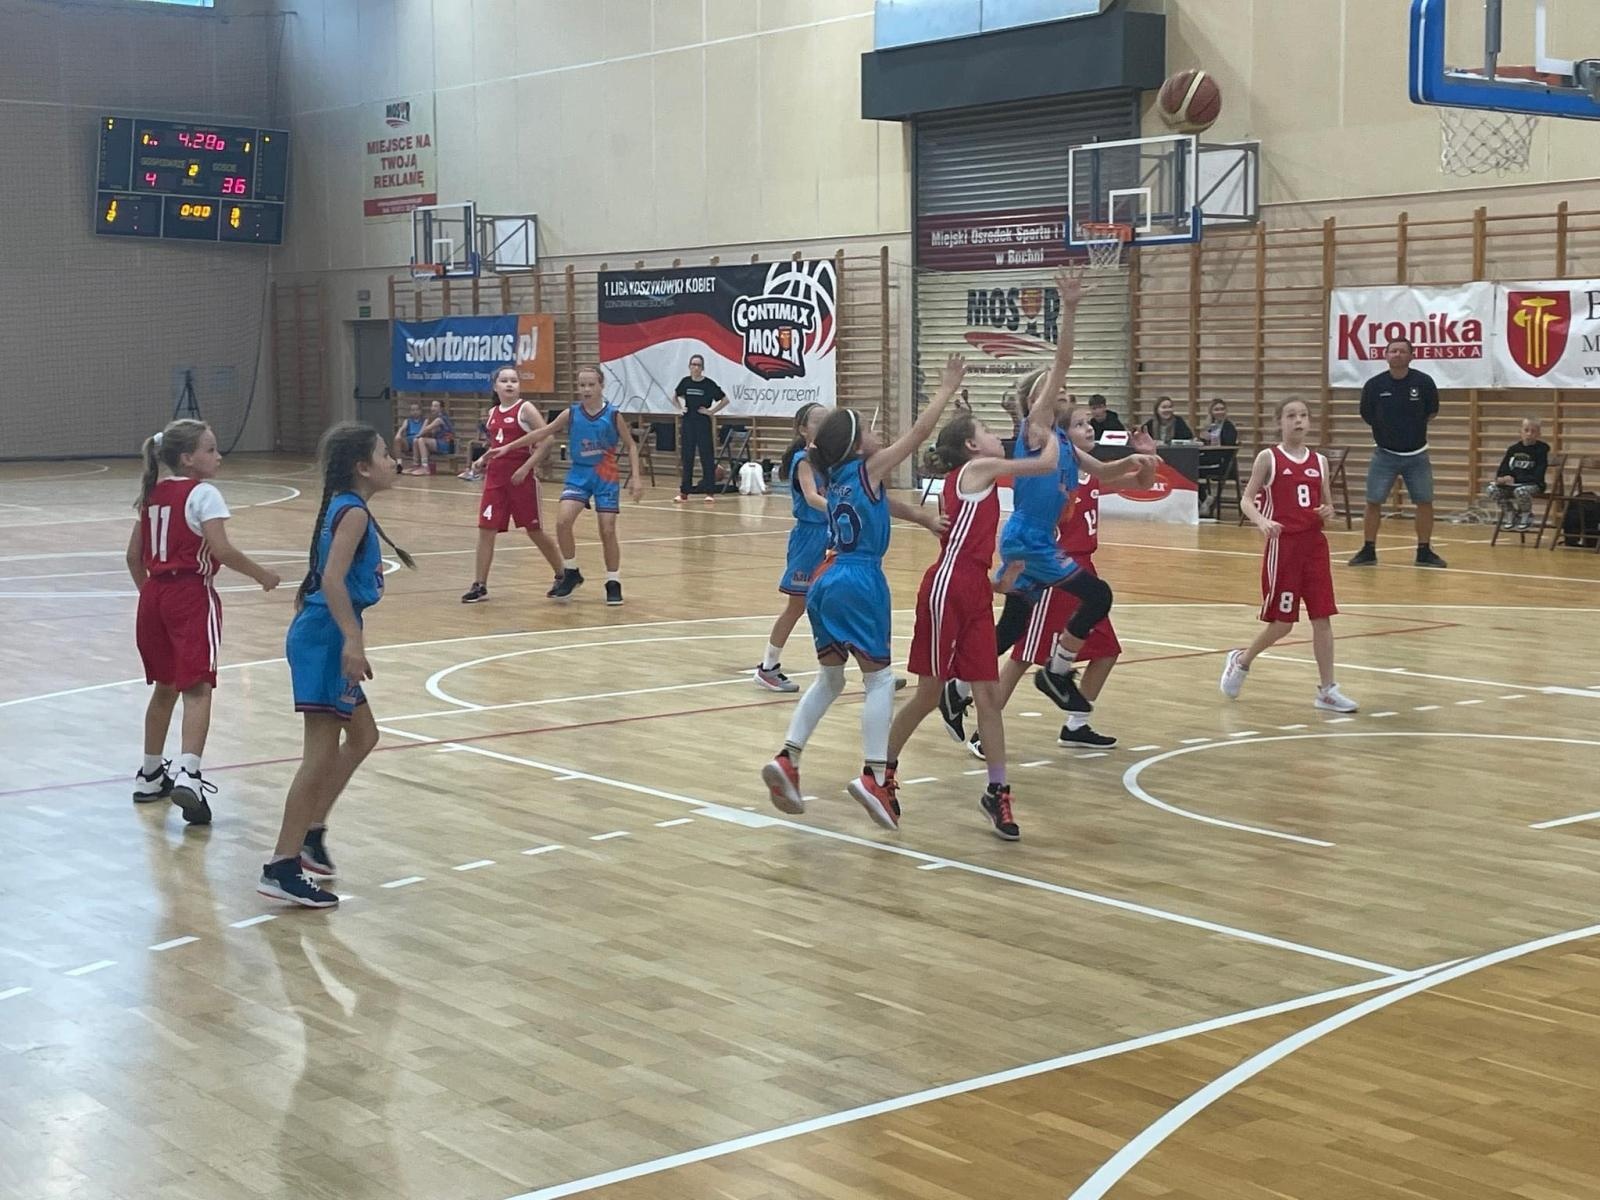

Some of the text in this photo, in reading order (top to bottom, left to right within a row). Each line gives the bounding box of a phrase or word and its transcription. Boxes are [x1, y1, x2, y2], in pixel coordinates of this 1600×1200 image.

[367, 133, 431, 155] MIEJSCE NA
[381, 153, 418, 171] TWOJĄ
[145, 172, 157, 187] 4
[222, 177, 246, 195] 36
[374, 171, 424, 189] REKLAMĘ
[180, 203, 212, 218] 0:00
[931, 229, 968, 248] Miejski
[1016, 223, 1051, 244] Sportu
[995, 247, 1044, 265] w Bochni
[604, 281, 609, 296] 1
[610, 281, 628, 296] LIGA
[685, 277, 716, 293] KOBIET
[737, 303, 810, 328] CONTIMAX
[406, 326, 538, 367] sportomaks.pl
[1338, 313, 1483, 361] Kronika
[733, 384, 820, 405] Wszyscy razem!
[495, 428, 504, 444] 4
[1297, 484, 1311, 508] 8
[482, 504, 493, 521] 4
[148, 504, 172, 563] 11
[1279, 591, 1295, 614] 8
